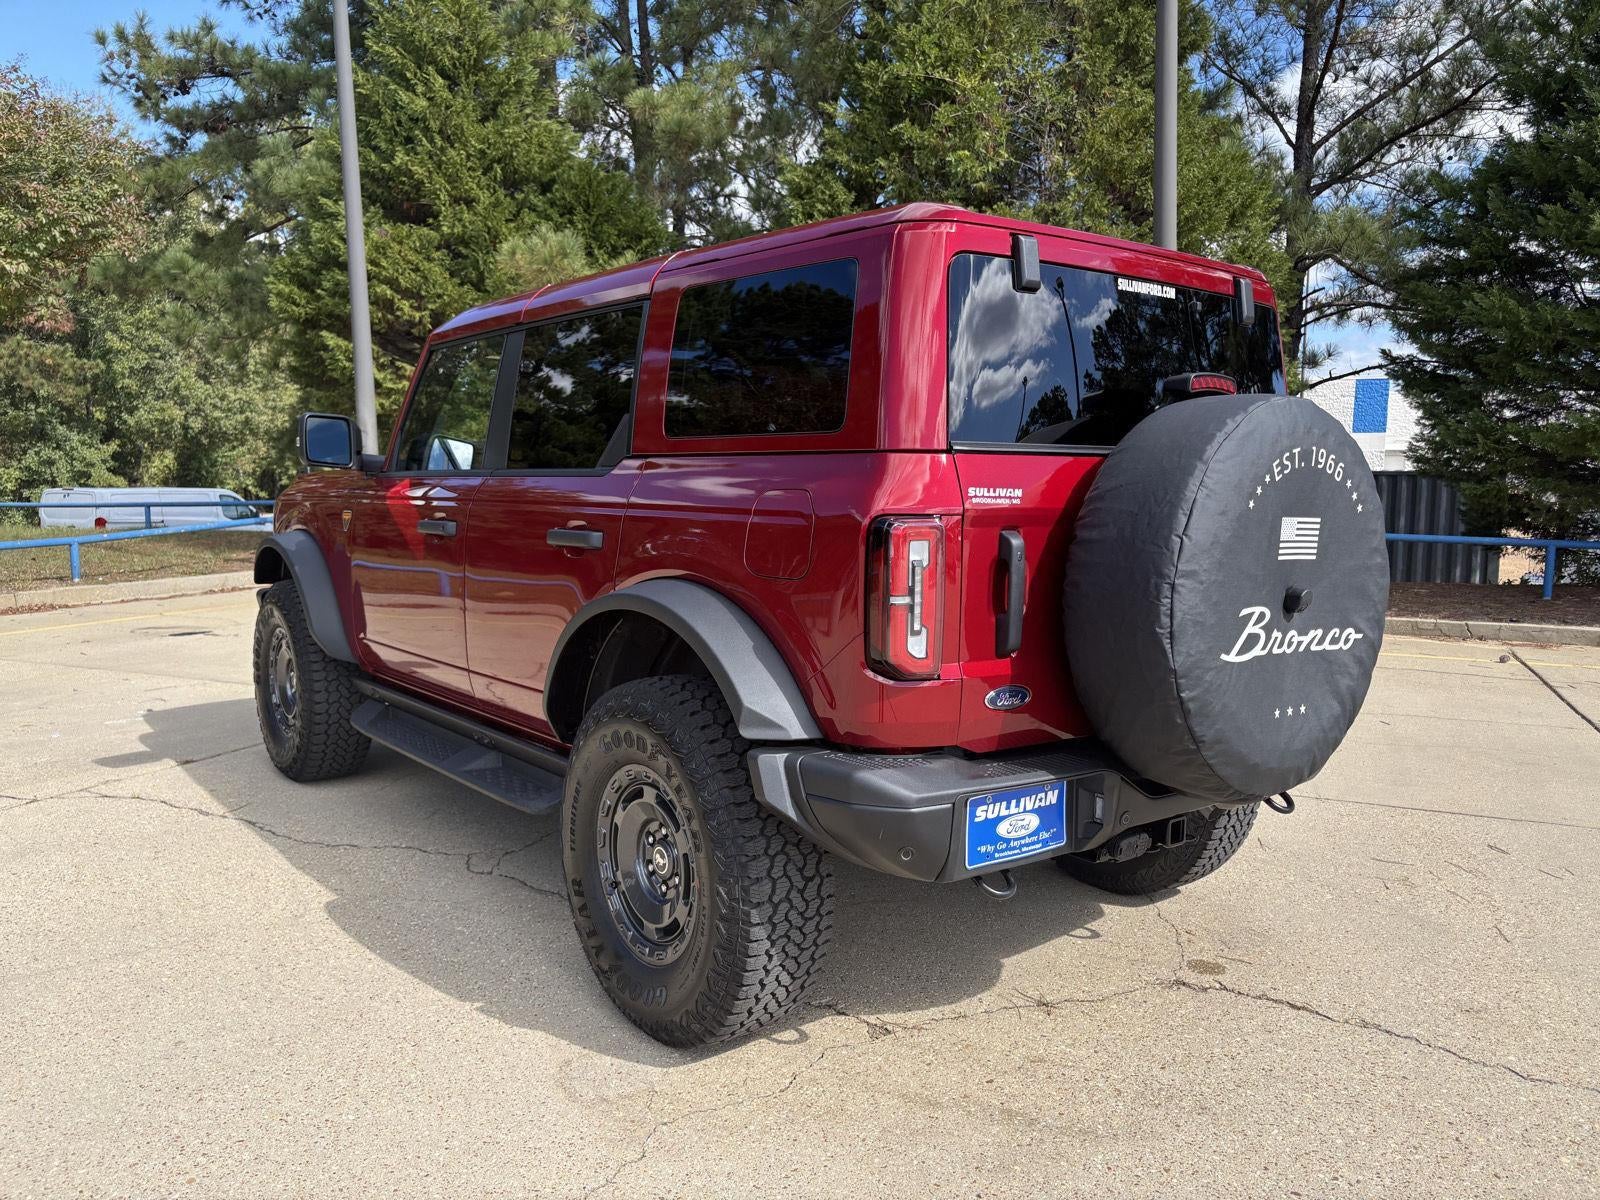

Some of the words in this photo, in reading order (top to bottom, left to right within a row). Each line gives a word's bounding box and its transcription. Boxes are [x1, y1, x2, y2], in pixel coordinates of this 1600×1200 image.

[1117, 277, 1176, 300] SULLIVANFORD.COM
[1272, 447, 1305, 482] EST.
[1311, 446, 1345, 482] 1966
[967, 486, 1023, 498] SULLIVAN
[1219, 606, 1364, 663] Bronco
[996, 691, 1023, 706] Ford
[974, 789, 1059, 823] SULLIVAN
[1006, 817, 1032, 835] Ford
[997, 841, 1007, 850] Go
[1008, 835, 1038, 848] Anywhere
